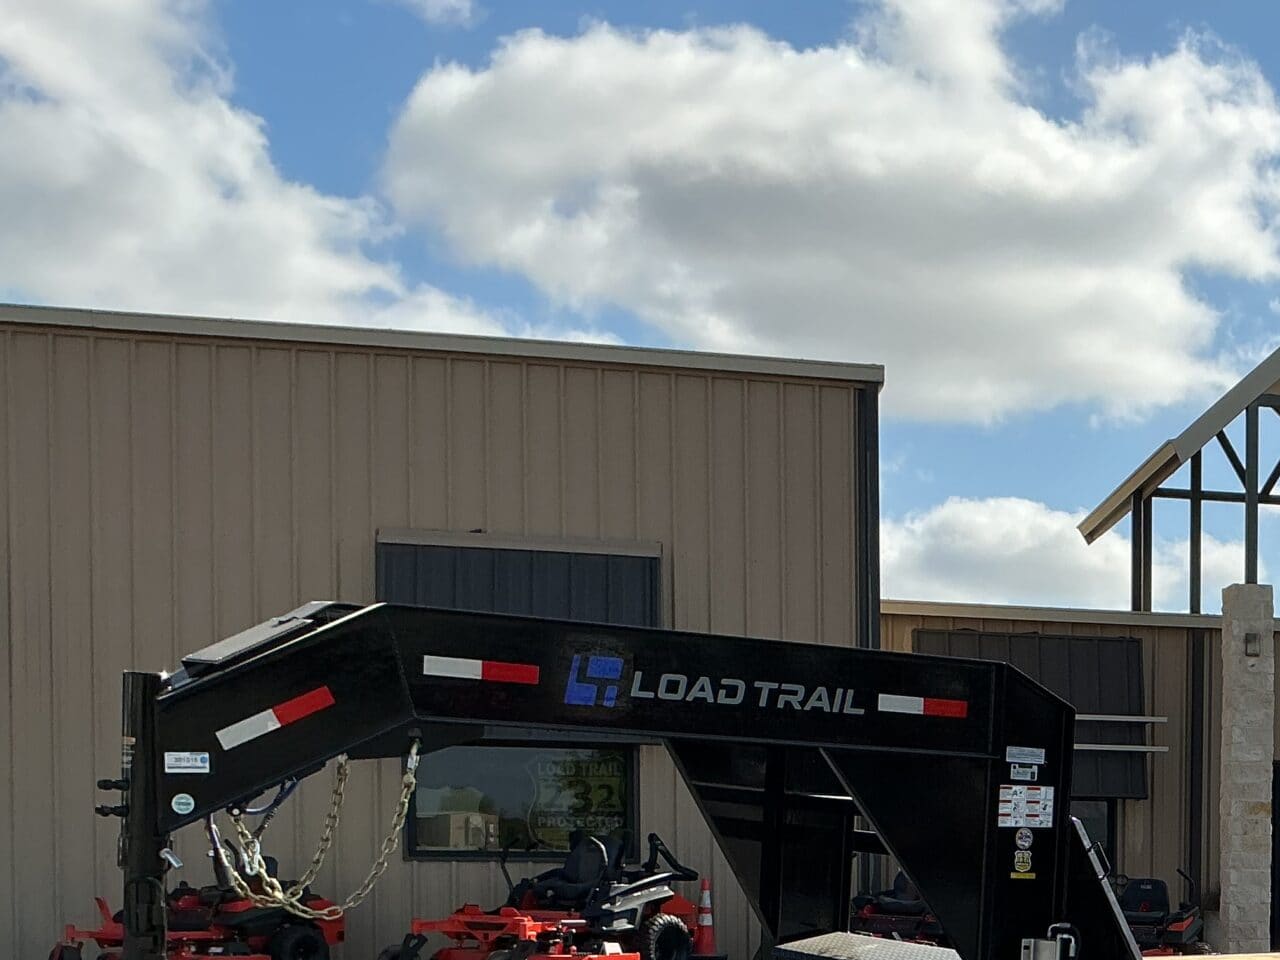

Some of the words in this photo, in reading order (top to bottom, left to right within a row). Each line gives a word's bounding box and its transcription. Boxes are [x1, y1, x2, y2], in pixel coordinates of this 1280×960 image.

[630, 671, 747, 705] LOAD
[753, 680, 865, 715] TRAIL
[537, 761, 576, 776] LOAD
[579, 761, 623, 777] TRAIL
